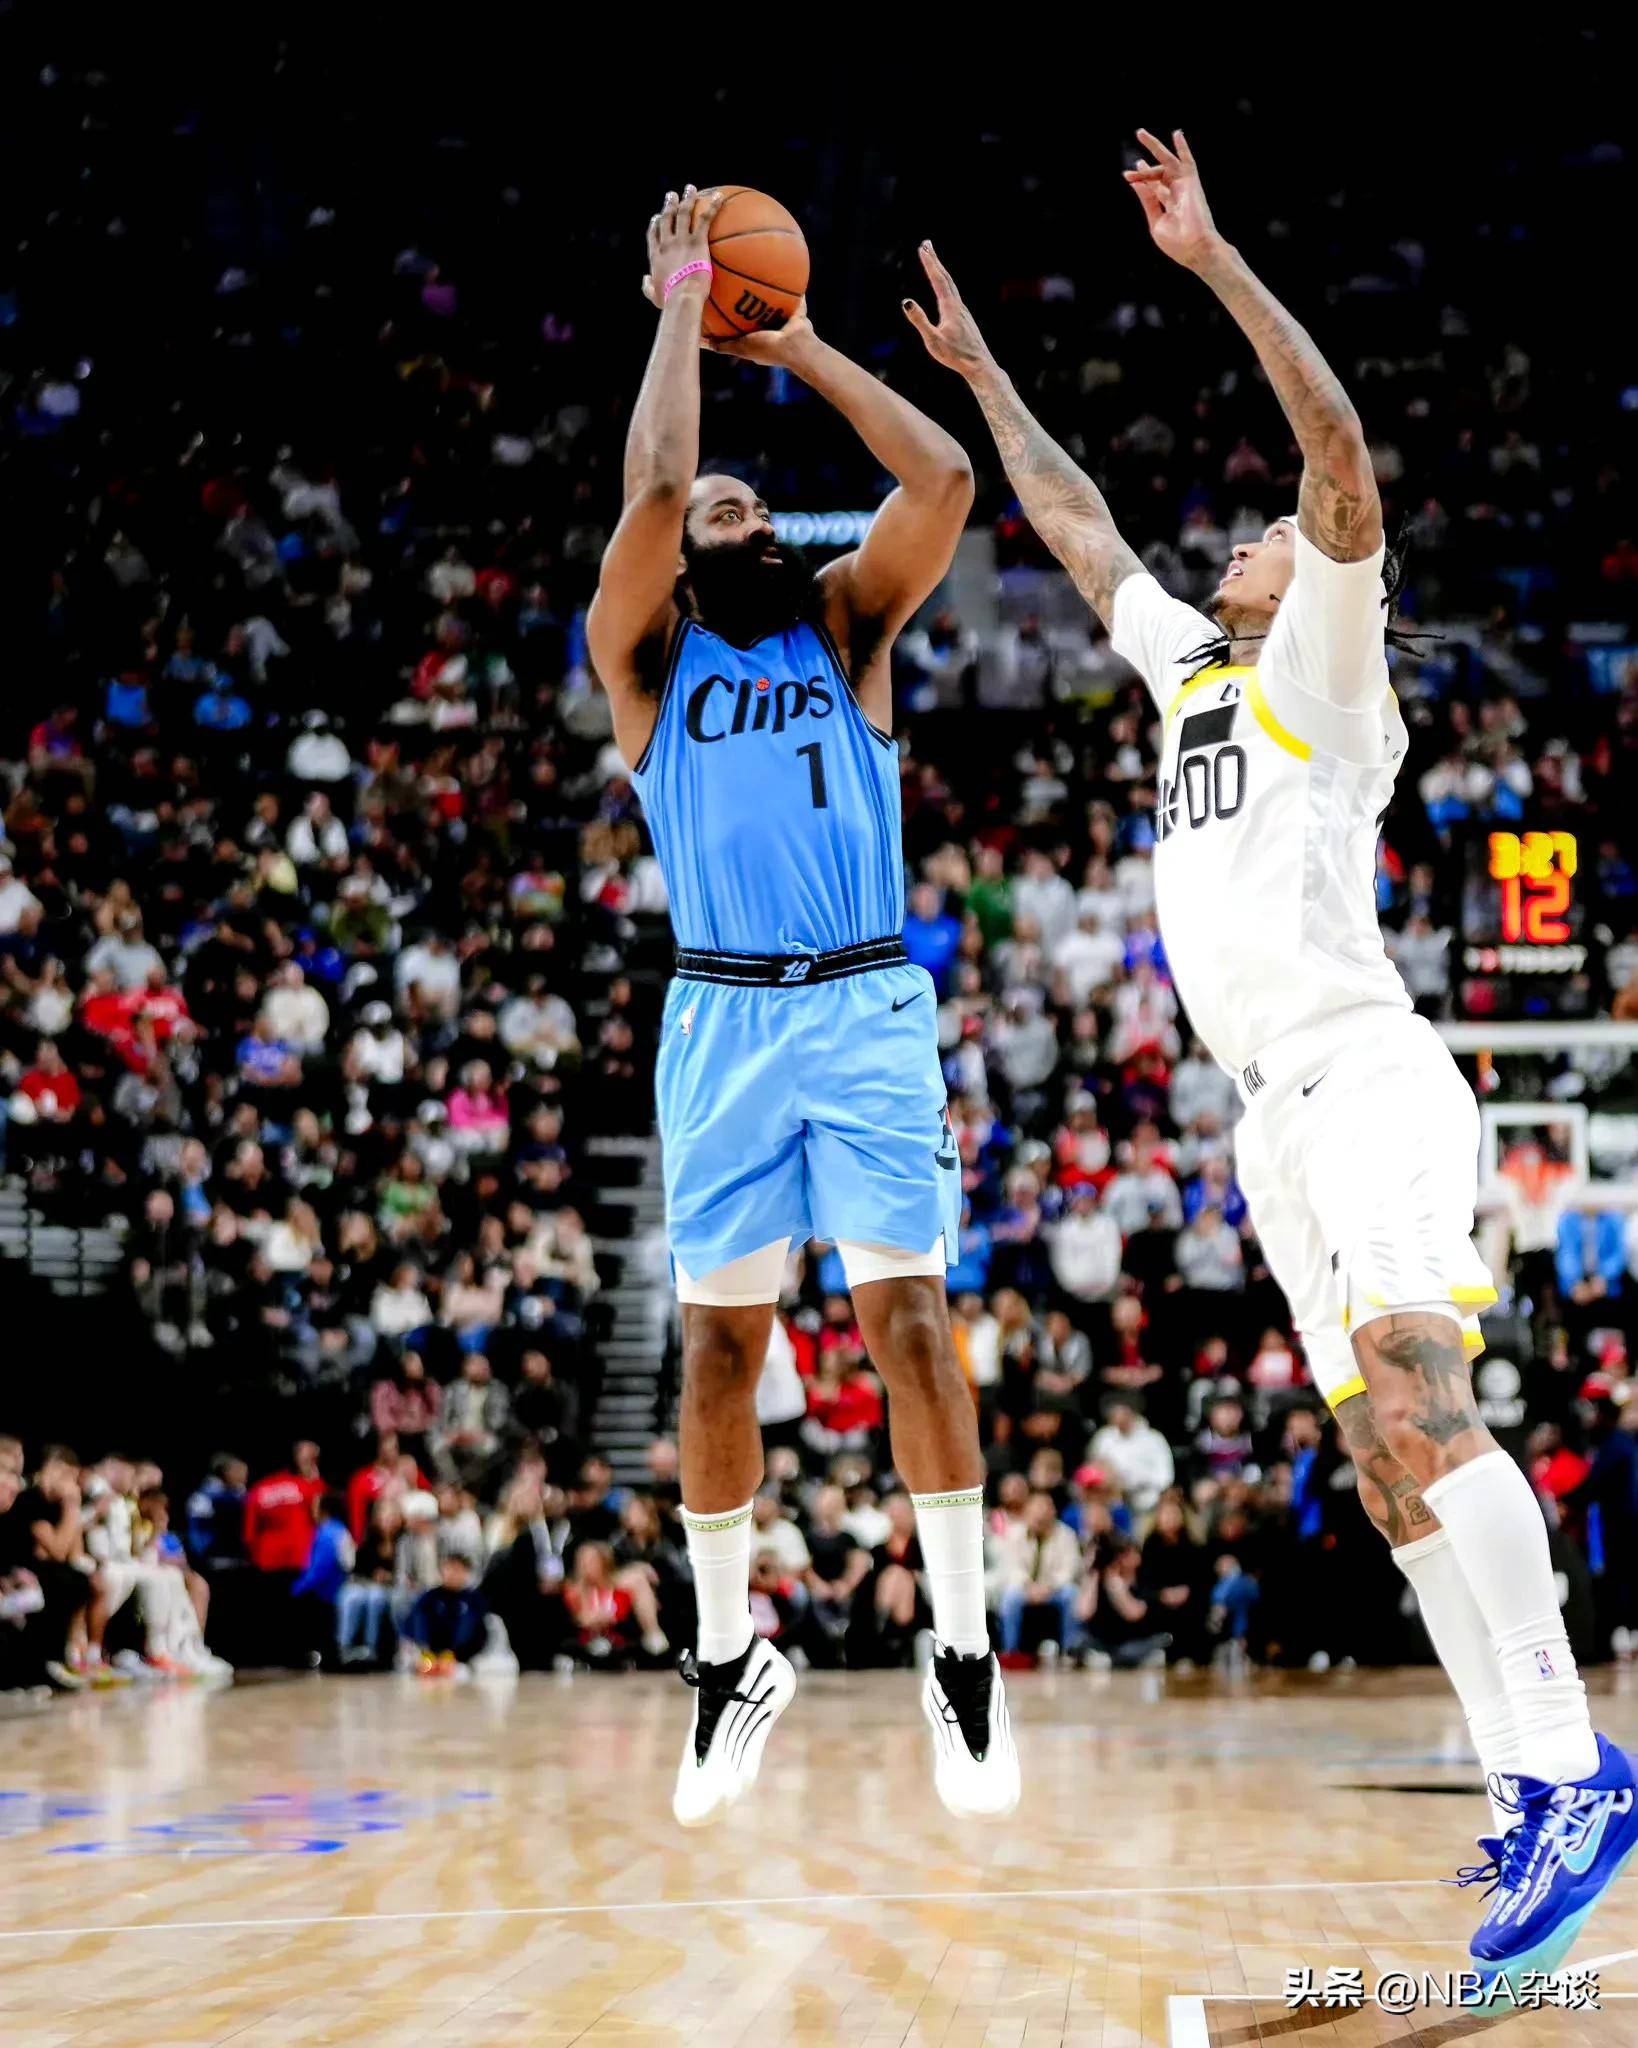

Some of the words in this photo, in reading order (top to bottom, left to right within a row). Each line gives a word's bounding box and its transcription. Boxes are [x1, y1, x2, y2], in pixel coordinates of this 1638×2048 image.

[685, 673, 834, 743] Clips
[796, 742, 828, 809] 1
[1183, 744, 1248, 830] 00
[1502, 872, 1570, 943] 12
